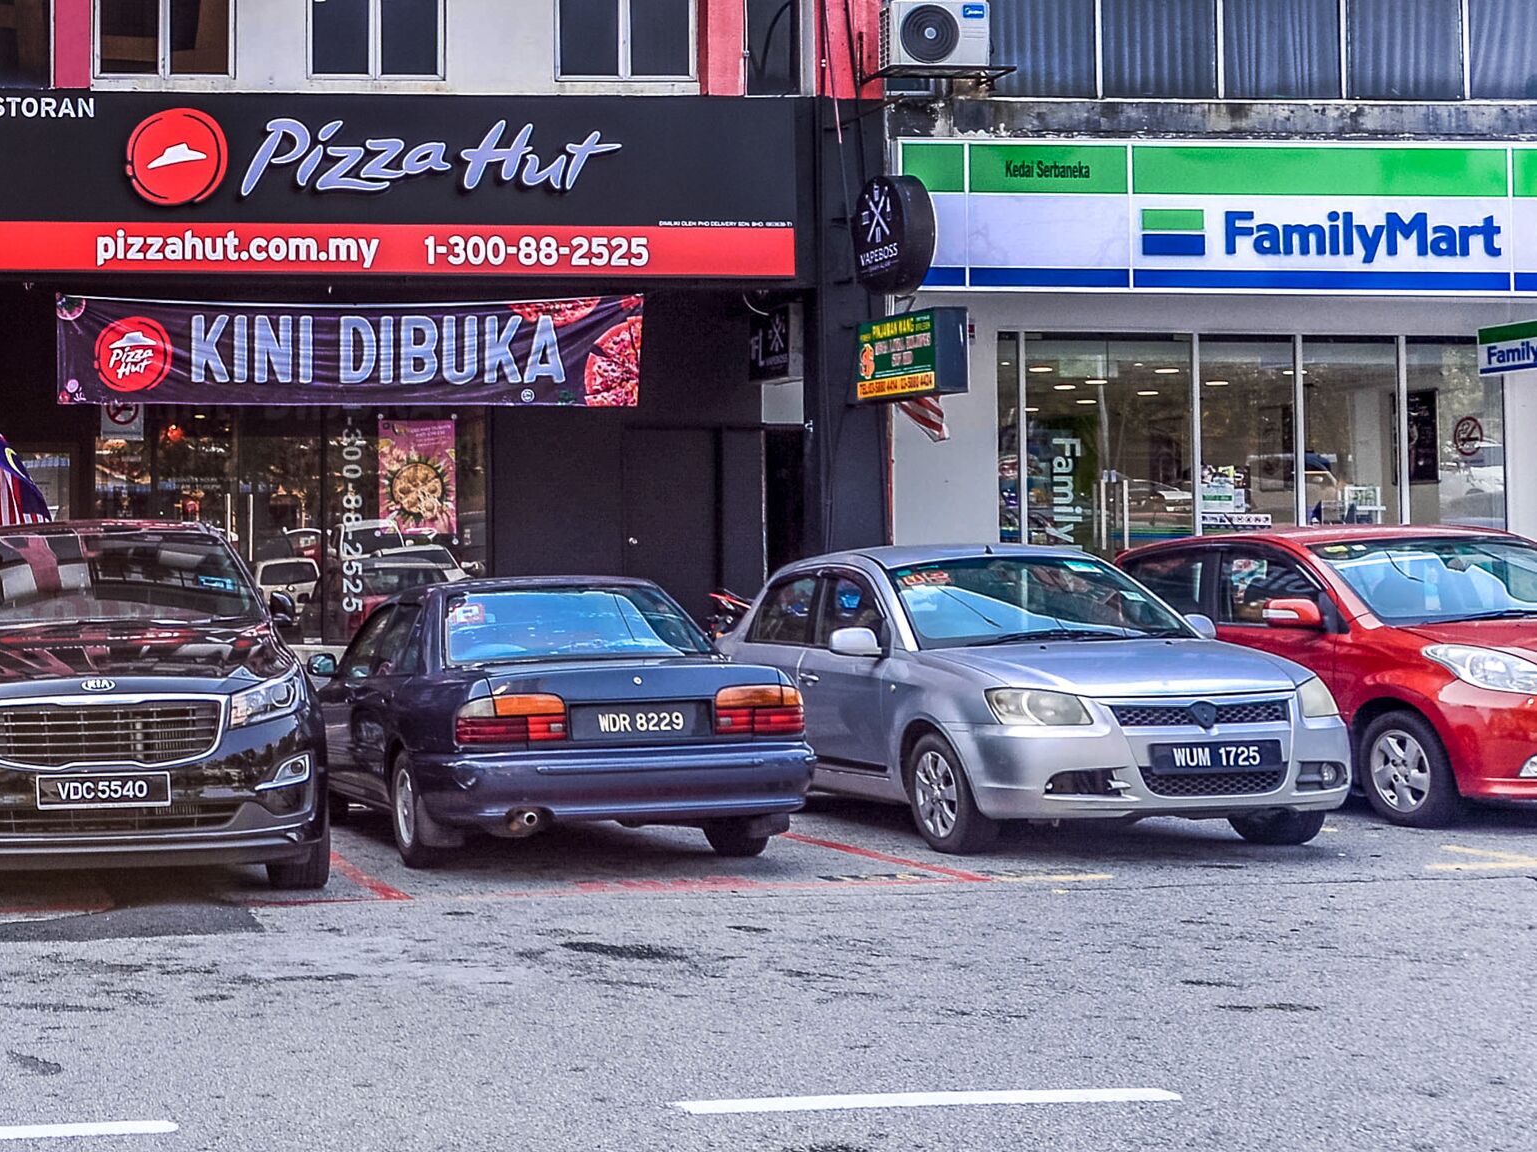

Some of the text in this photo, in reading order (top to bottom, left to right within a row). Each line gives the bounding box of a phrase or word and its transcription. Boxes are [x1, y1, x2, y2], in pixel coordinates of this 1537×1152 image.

[241, 118, 623, 198] Pizza Hut
[1005, 159, 1090, 179] Kedai Serbaneka
[1224, 210, 1502, 264] FamilyMart
[95, 232, 649, 269] pizzahut.com.my 1-300-88-2525
[860, 243, 898, 266] VAPEBOSS
[109, 347, 154, 369] Pizza
[191, 315, 567, 384] KINI DIBUKA
[116, 359, 153, 379] Hut
[87, 680, 111, 690] KIA
[598, 711, 684, 733] WDR 8229
[1172, 745, 1260, 768] WUM 1725
[57, 780, 148, 800] VDC 5540
